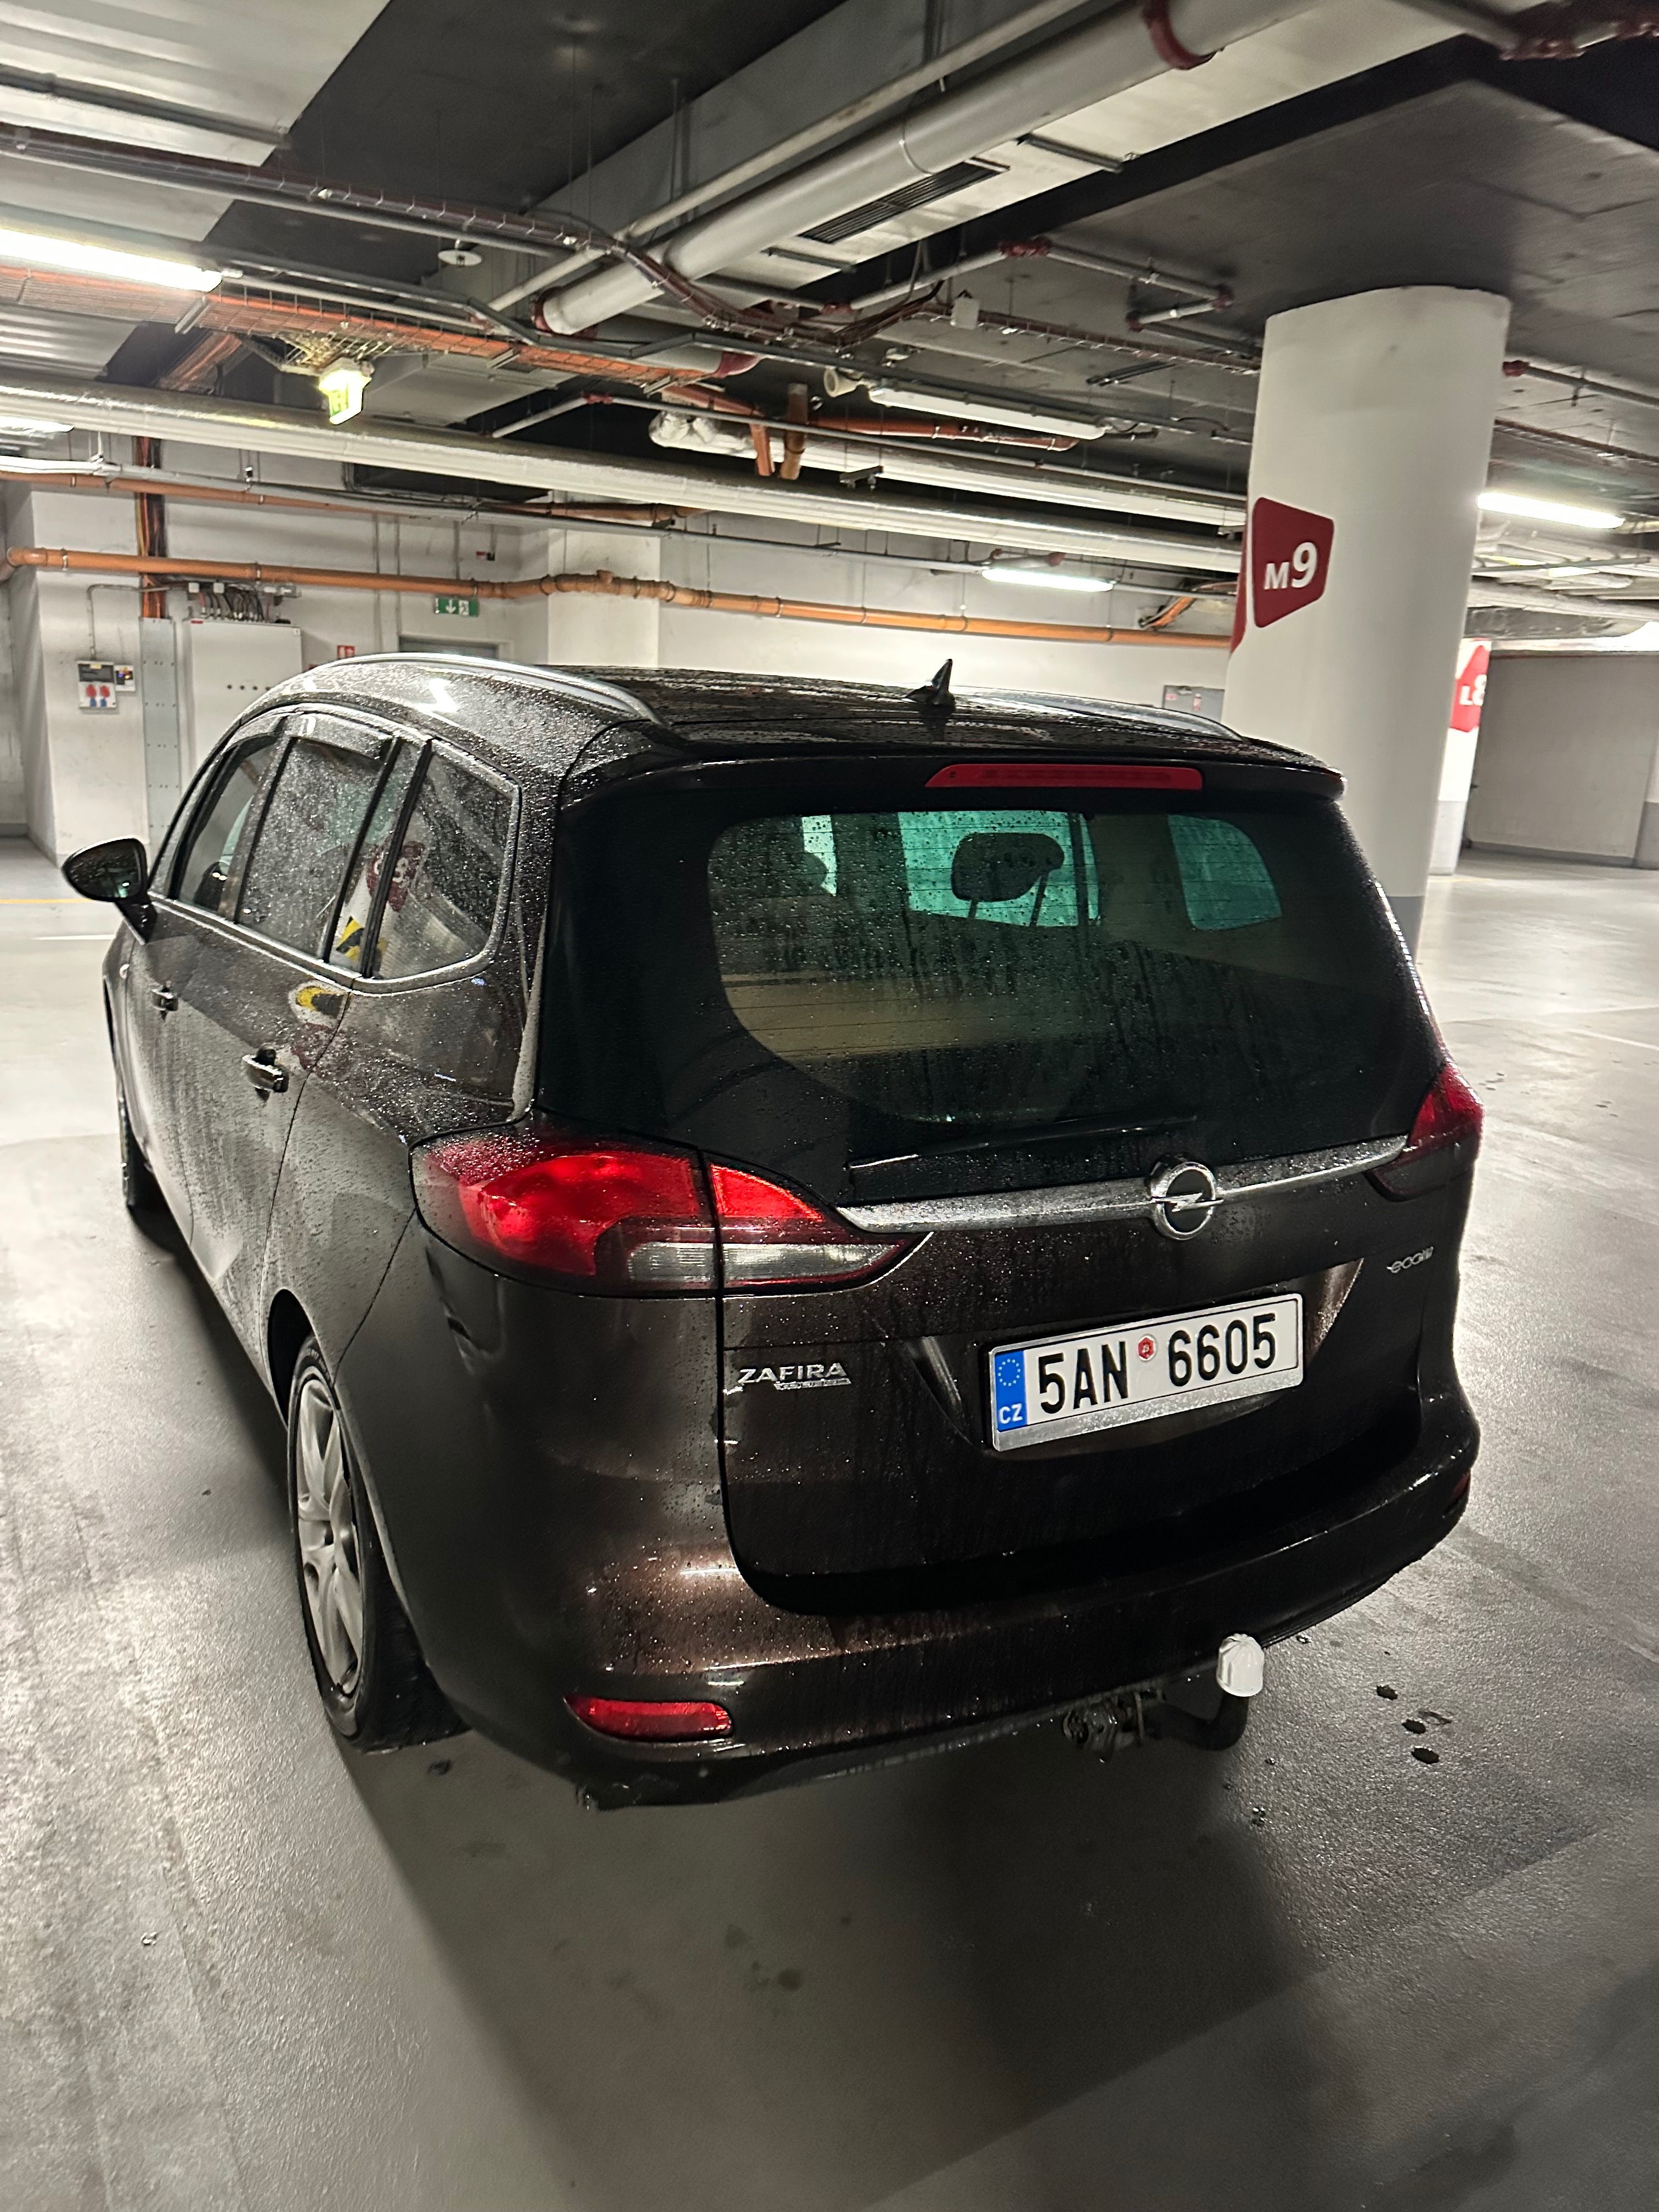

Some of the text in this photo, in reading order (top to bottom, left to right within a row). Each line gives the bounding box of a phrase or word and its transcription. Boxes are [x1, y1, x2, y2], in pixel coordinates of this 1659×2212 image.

[1263, 541, 1318, 590] M9
[738, 1362, 848, 1384] ZAFIRA
[1038, 1313, 1276, 1414] 5AN 6605
[998, 1403, 1023, 1424] CZ
